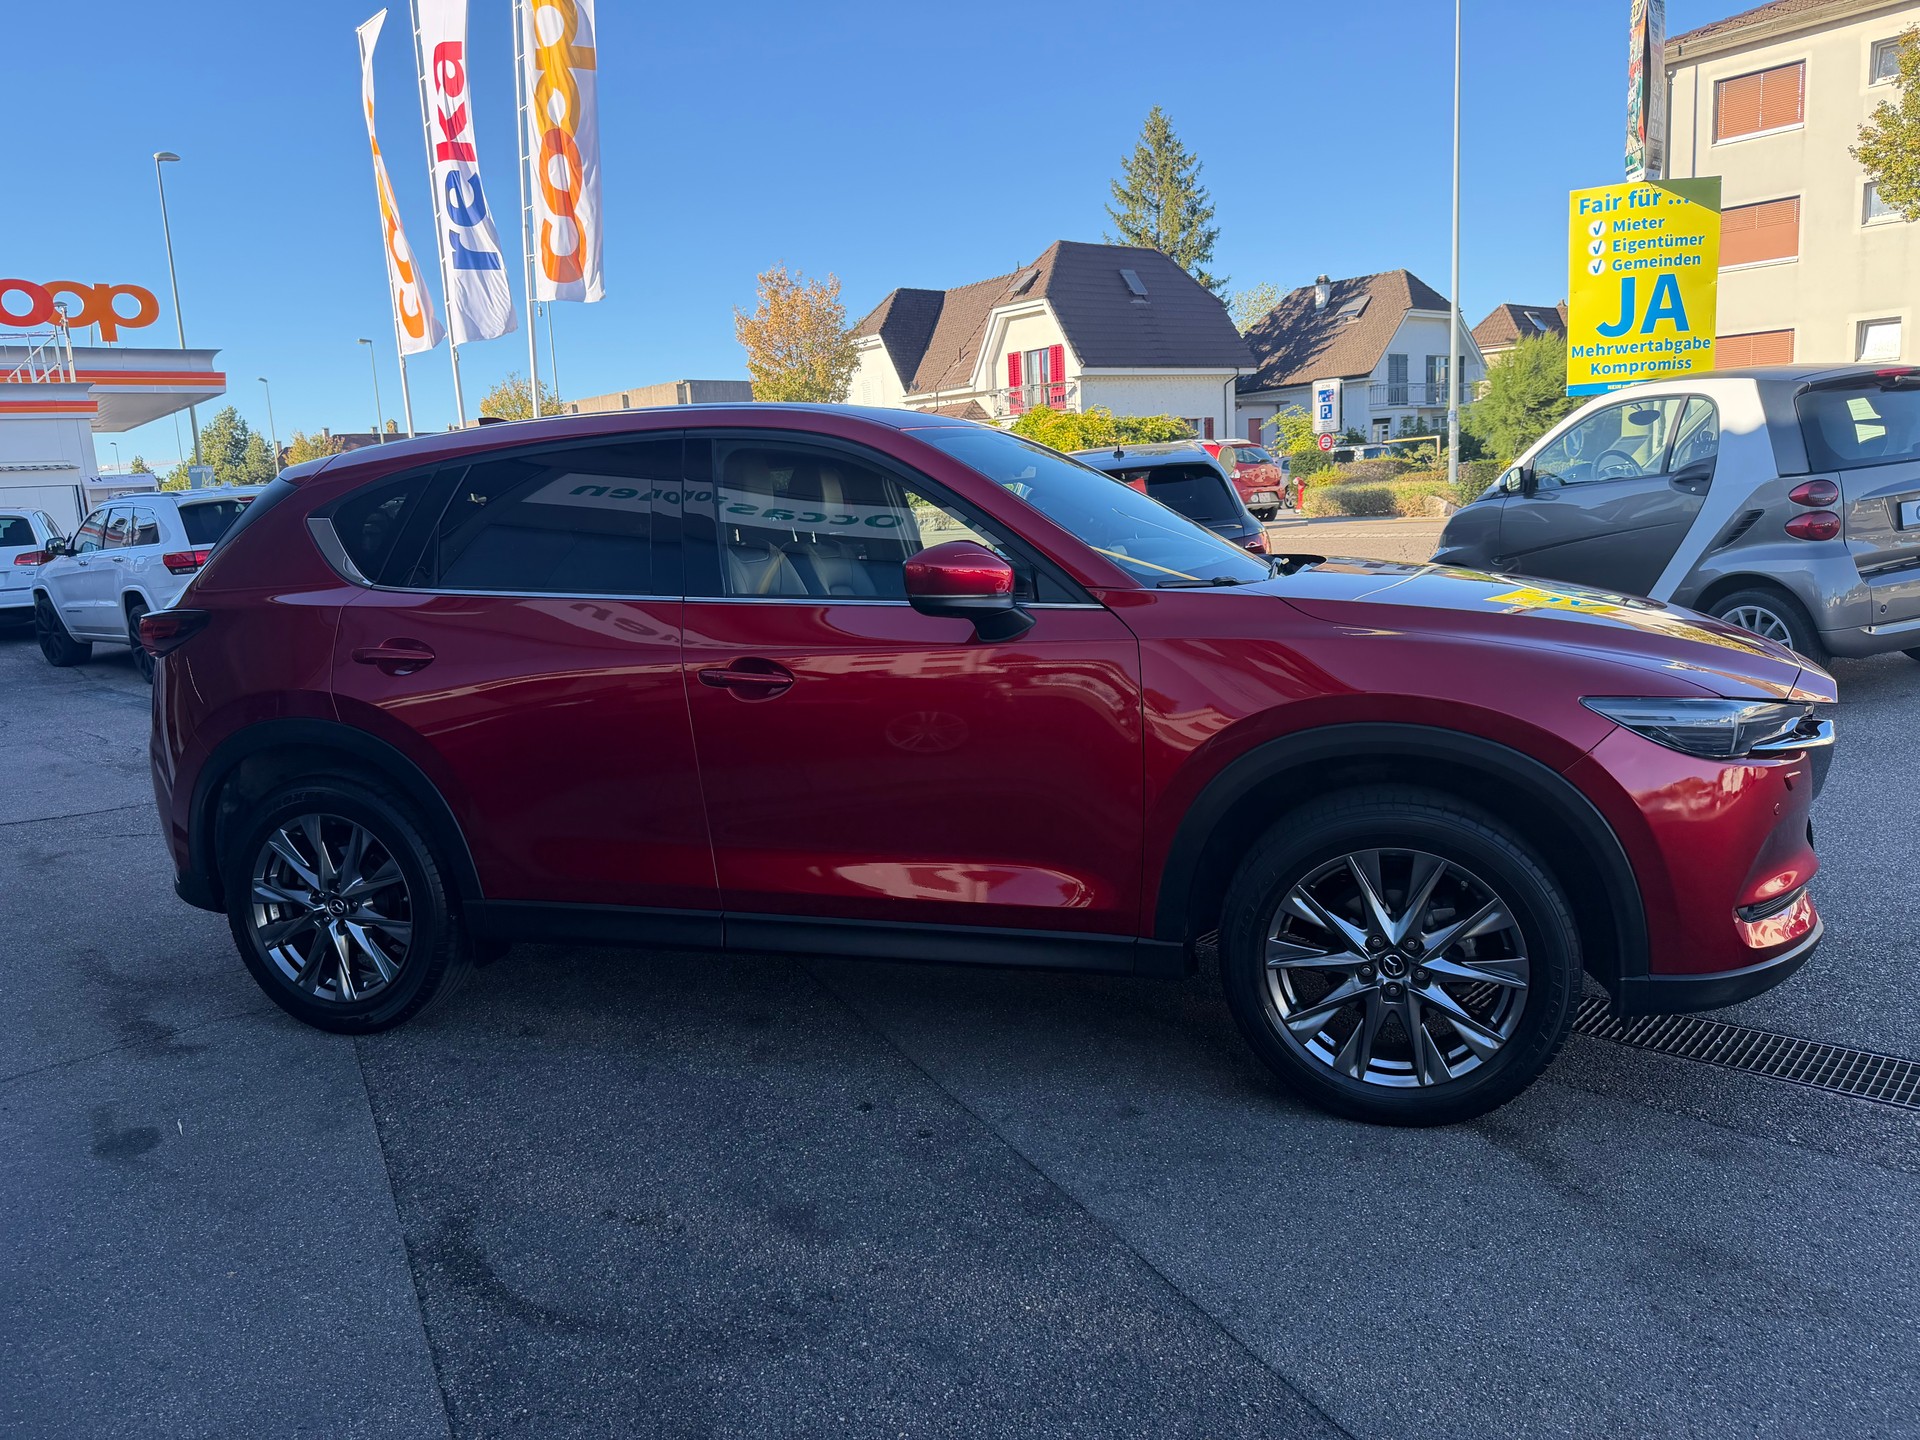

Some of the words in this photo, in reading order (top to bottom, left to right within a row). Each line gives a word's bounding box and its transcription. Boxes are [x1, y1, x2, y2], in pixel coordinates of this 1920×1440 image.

[533, 0, 597, 284] coop
[433, 41, 502, 271] reka
[1579, 193, 1622, 215] Fair
[1628, 188, 1662, 209] für
[1613, 217, 1665, 233] Mieter
[1612, 234, 1705, 254] Eigentümer
[1612, 253, 1701, 271] Gemeinden
[1595, 273, 1690, 338] JA
[1571, 336, 1711, 359] Mehrwertabgabe
[1590, 356, 1692, 375] Kompromiss
